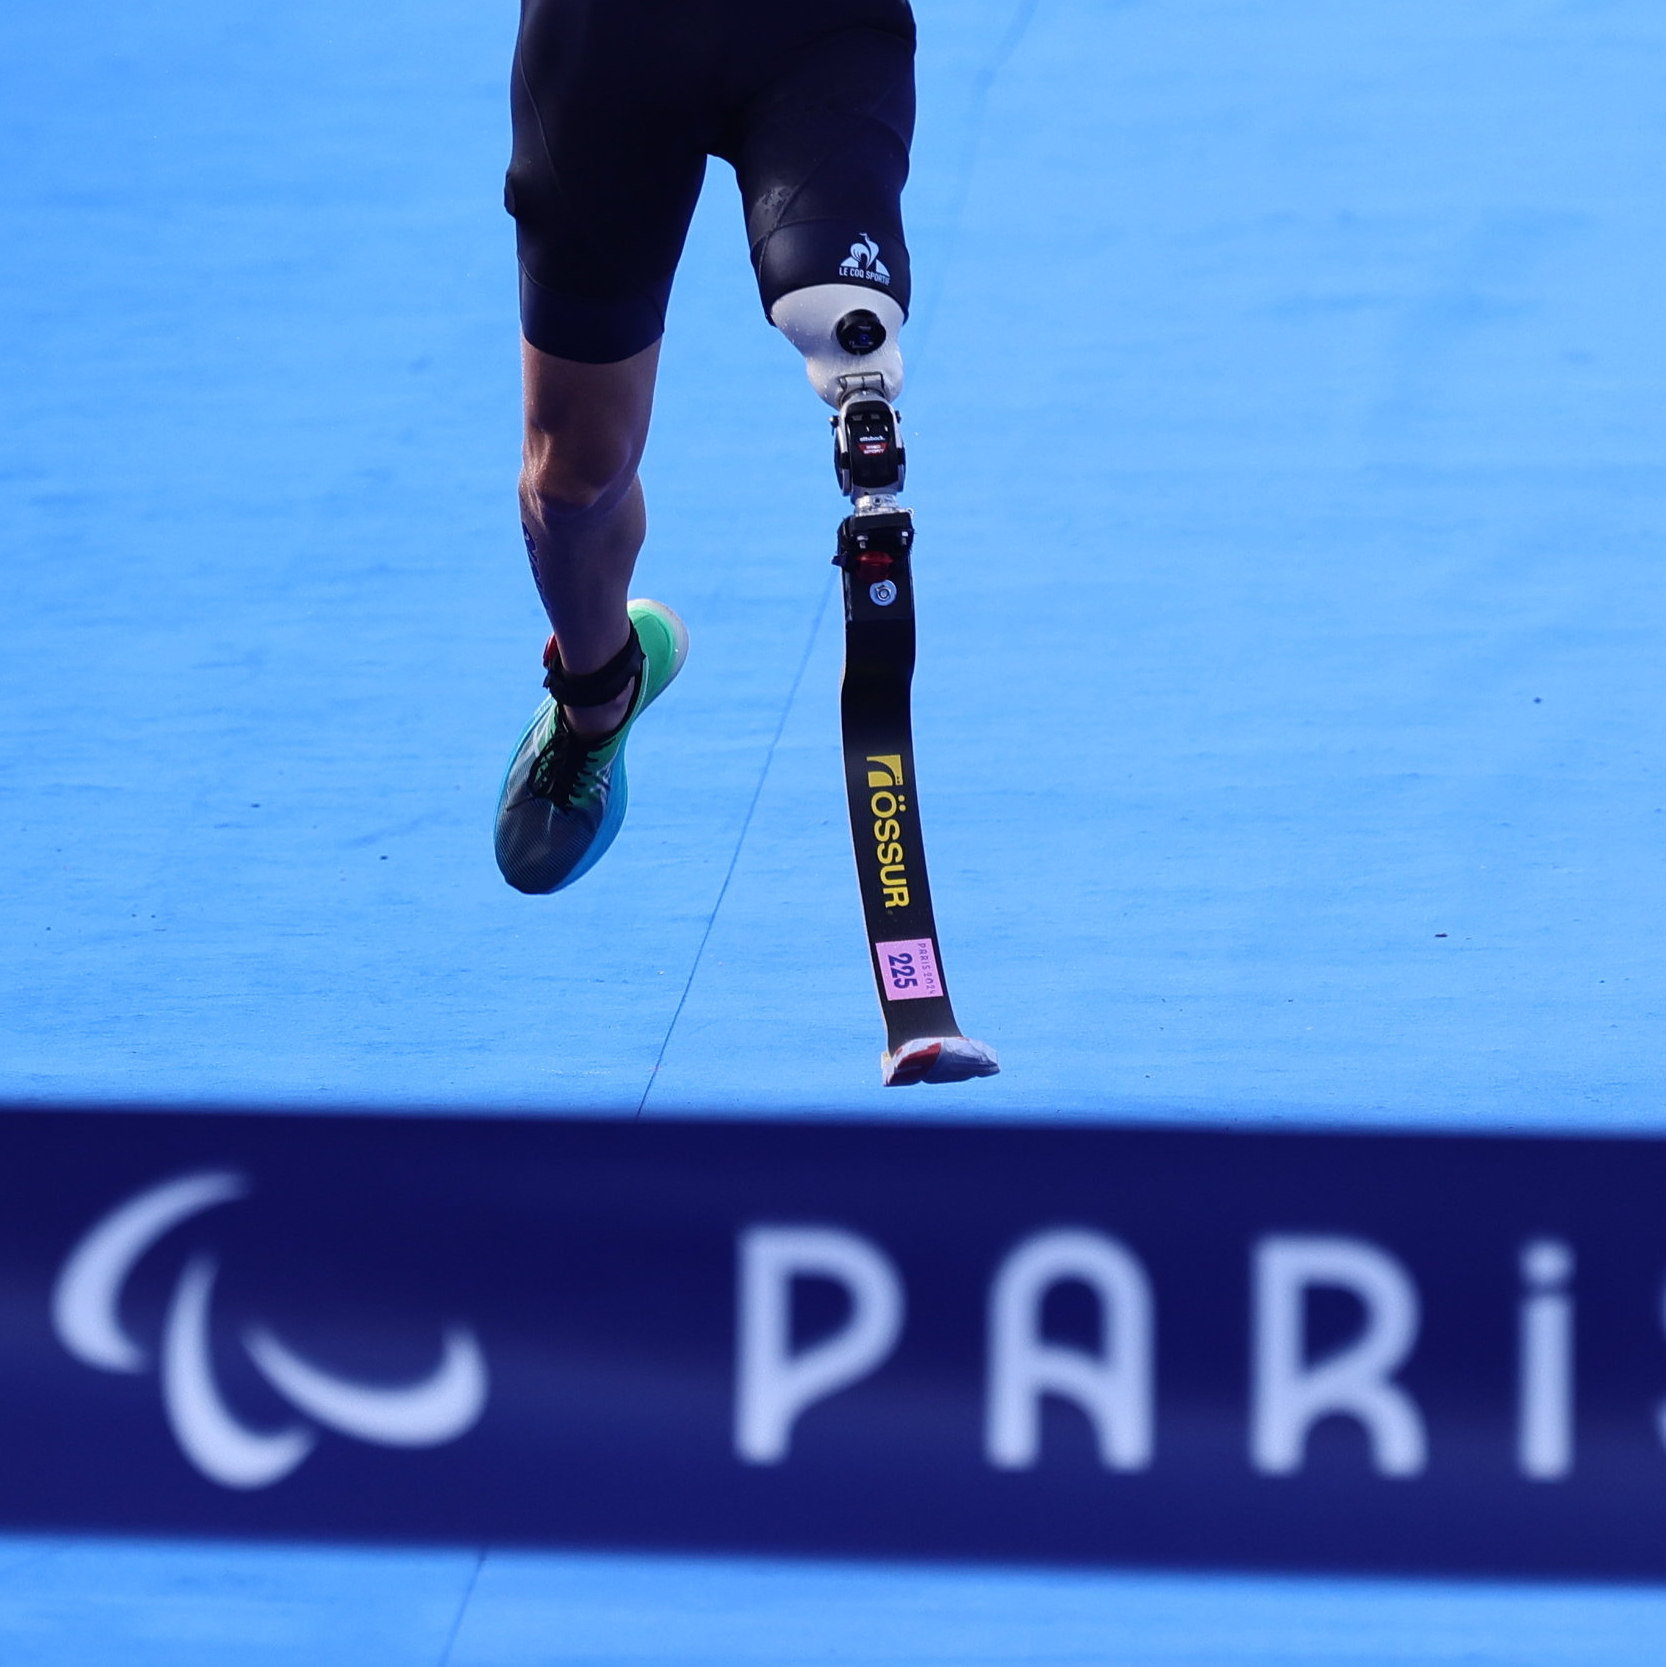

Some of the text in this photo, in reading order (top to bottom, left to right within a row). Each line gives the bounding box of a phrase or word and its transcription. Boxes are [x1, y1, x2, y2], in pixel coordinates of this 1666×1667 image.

[839, 267, 848, 276] LE
[850, 268, 864, 278] COQ
[871, 791, 910, 909] ÖSSUR
[888, 952, 918, 989] 225
